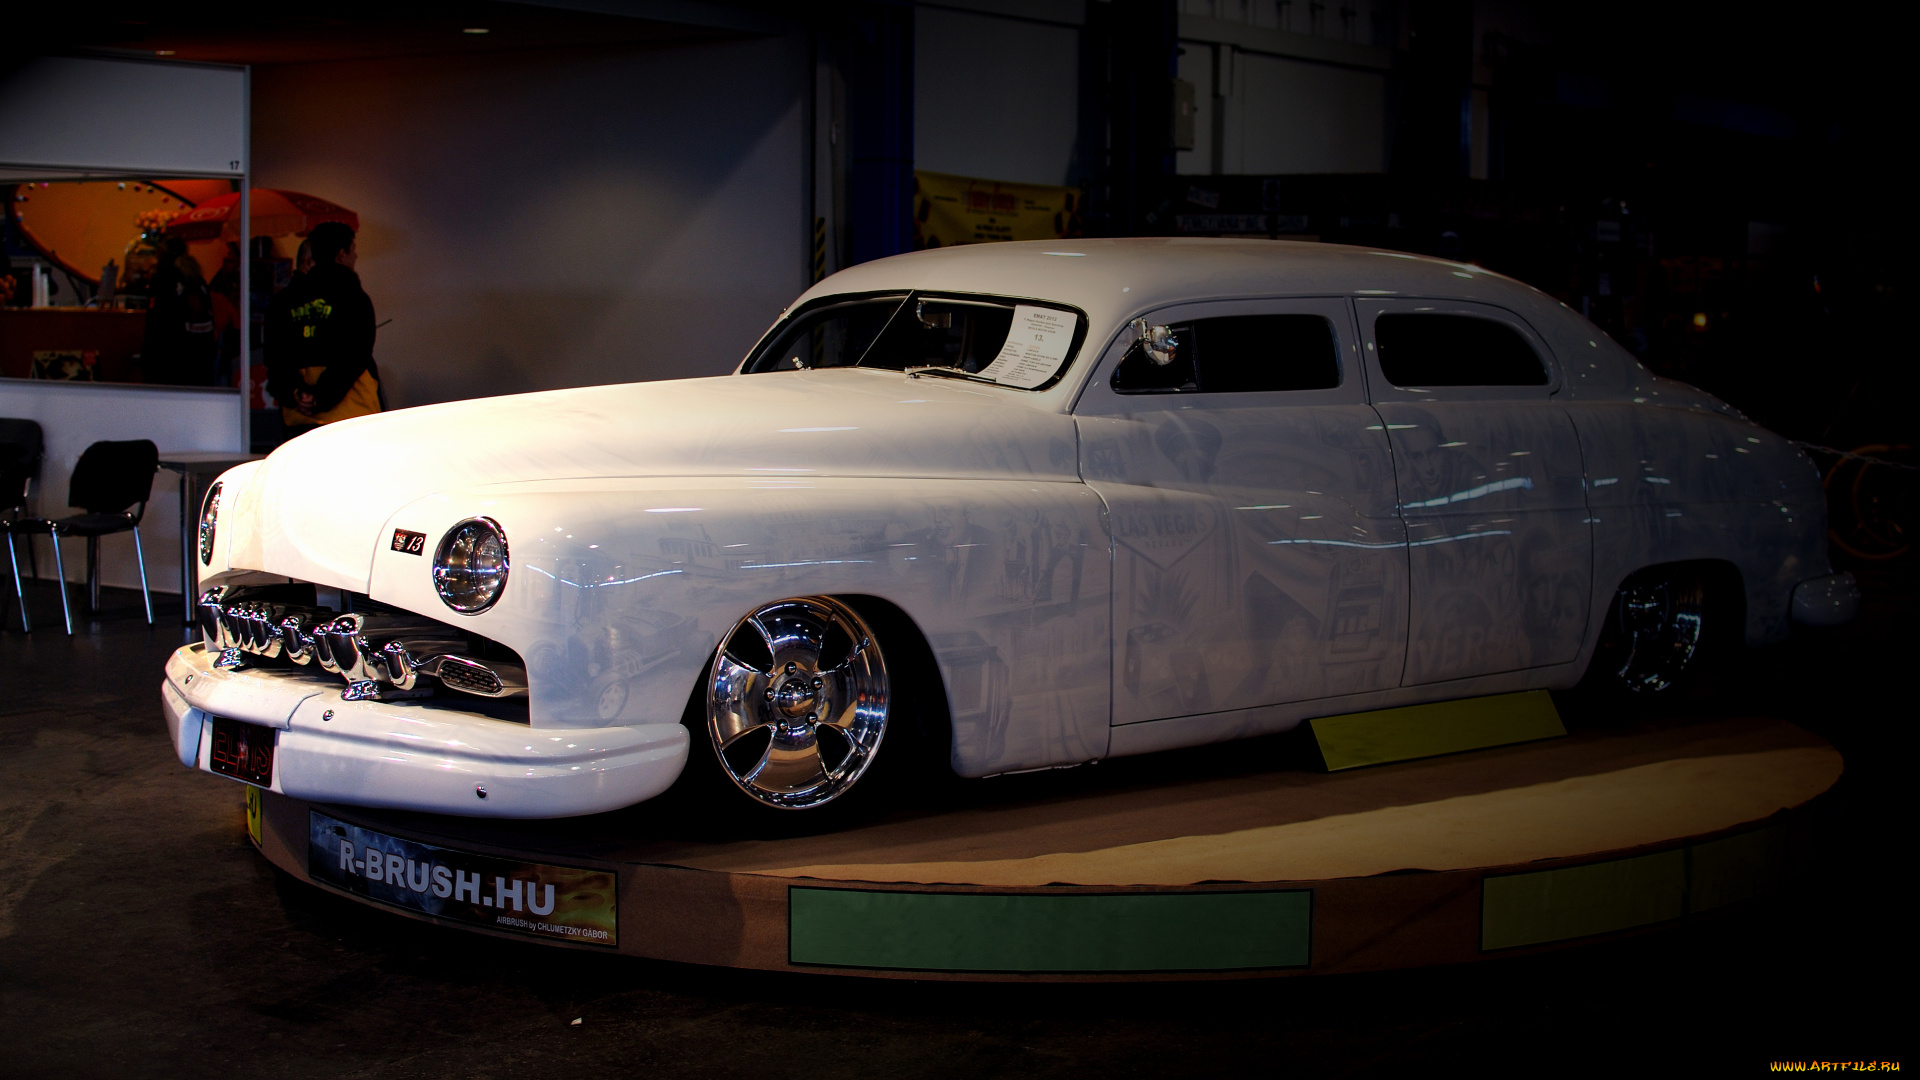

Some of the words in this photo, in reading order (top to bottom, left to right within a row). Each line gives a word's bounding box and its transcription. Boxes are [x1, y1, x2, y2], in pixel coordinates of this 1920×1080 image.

[230, 160, 240, 171] 17
[1117, 513, 1150, 538] LAS
[1151, 511, 1209, 537] VEGAS
[406, 536, 424, 552] 13
[213, 726, 273, 777] ELIS
[340, 838, 555, 916] R-BRUSH.HU
[497, 915, 528, 929] AIRBRUSH
[529, 922, 537, 931] by
[537, 922, 581, 937] CHLUMETZKY
[582, 927, 608, 940] GÁBOR
